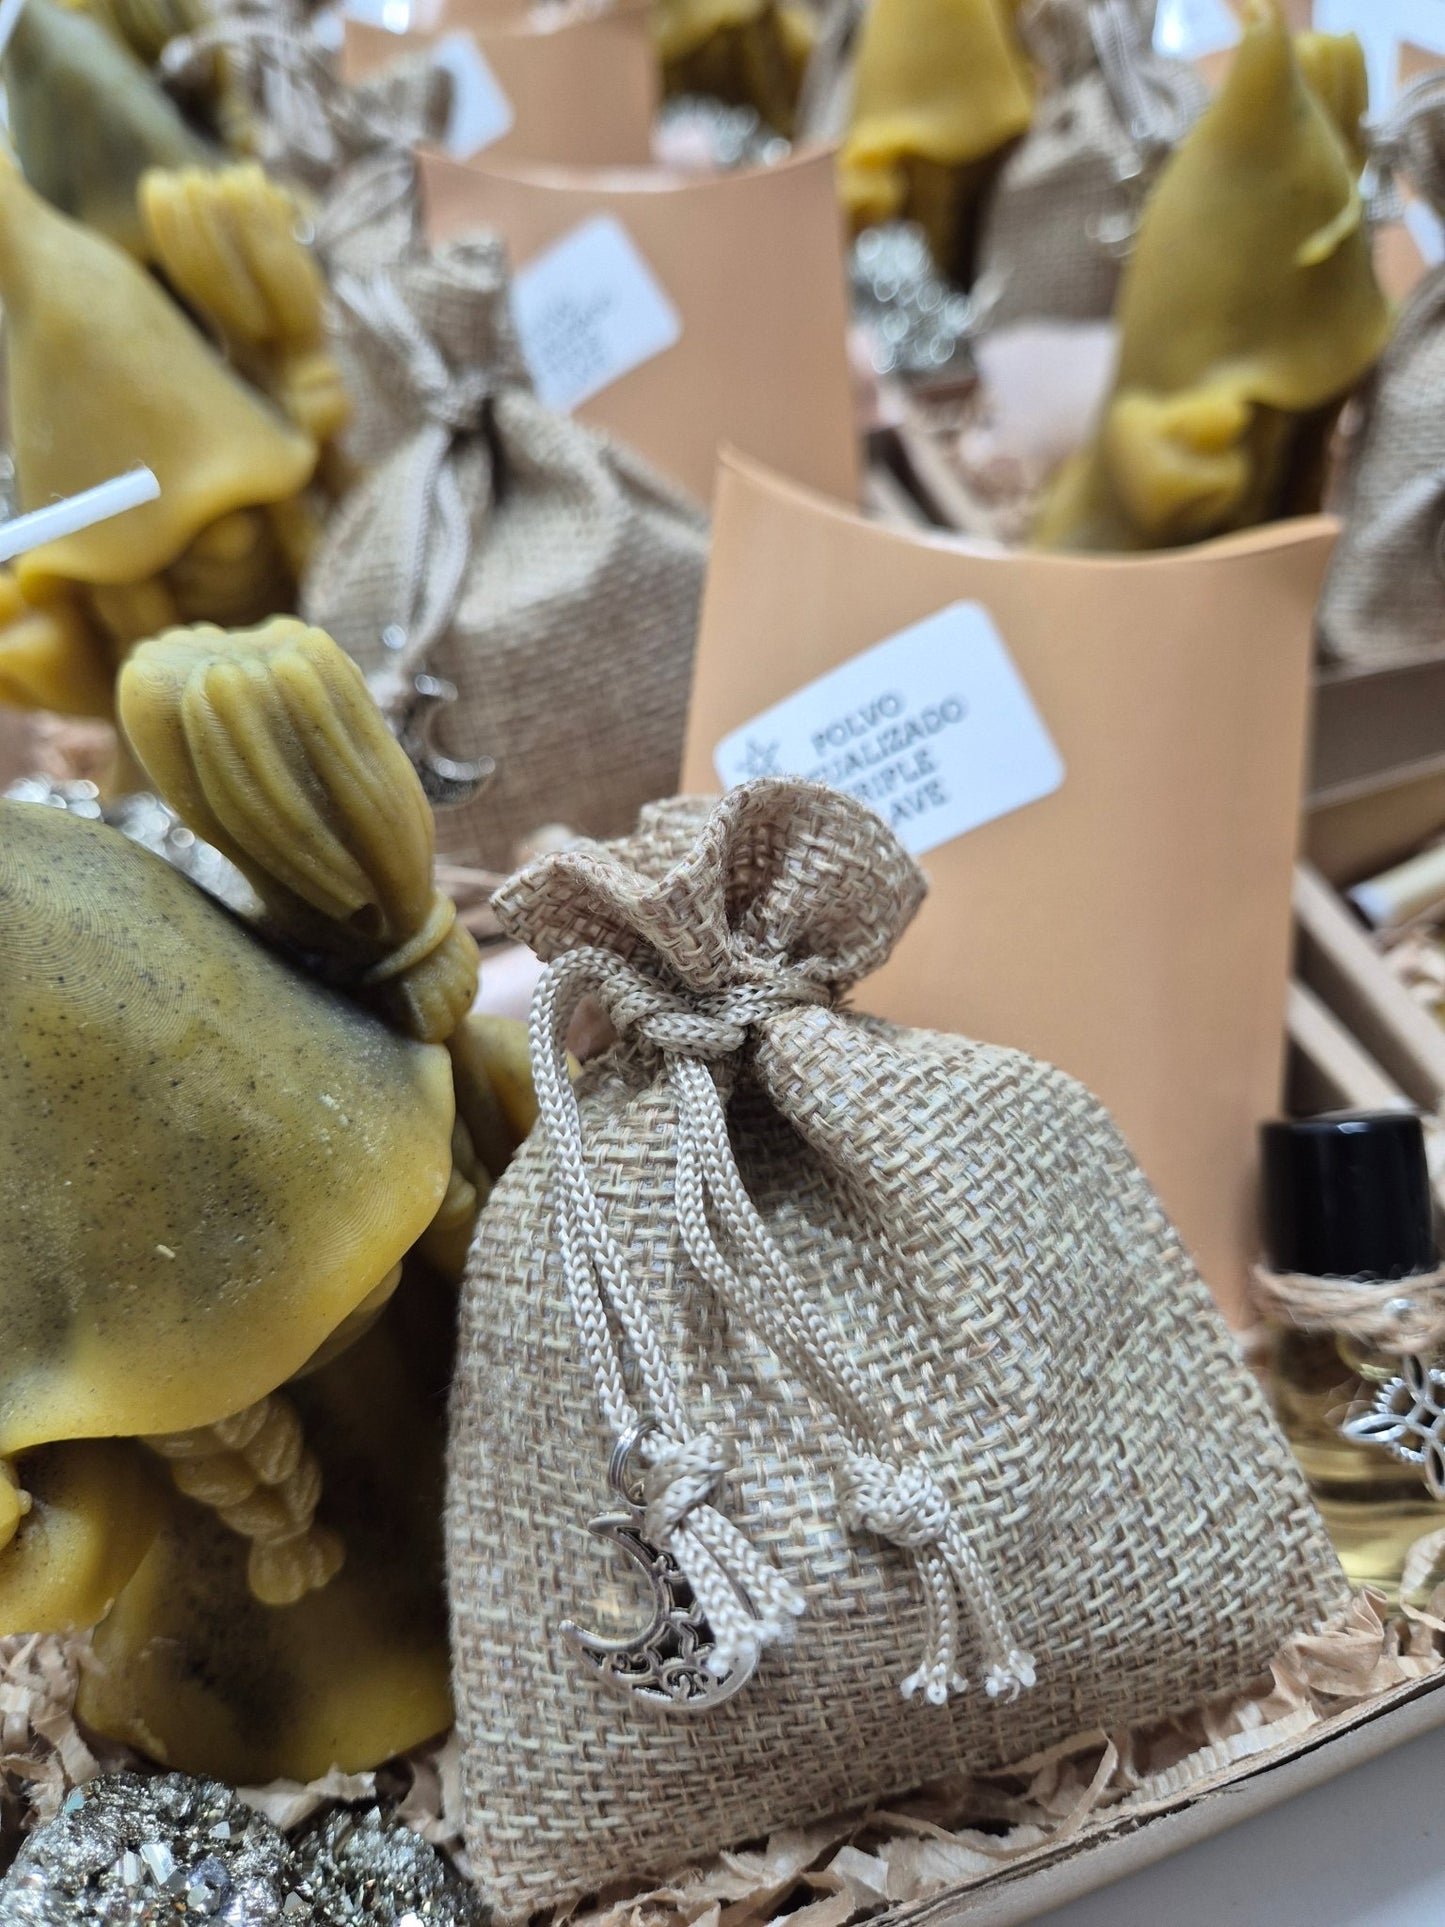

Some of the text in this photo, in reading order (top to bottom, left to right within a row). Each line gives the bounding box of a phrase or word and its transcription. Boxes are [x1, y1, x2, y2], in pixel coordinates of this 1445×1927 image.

[811, 692, 902, 755] POLVO
[852, 746, 939, 801] RIPLE
[889, 776, 949, 826] AVE
